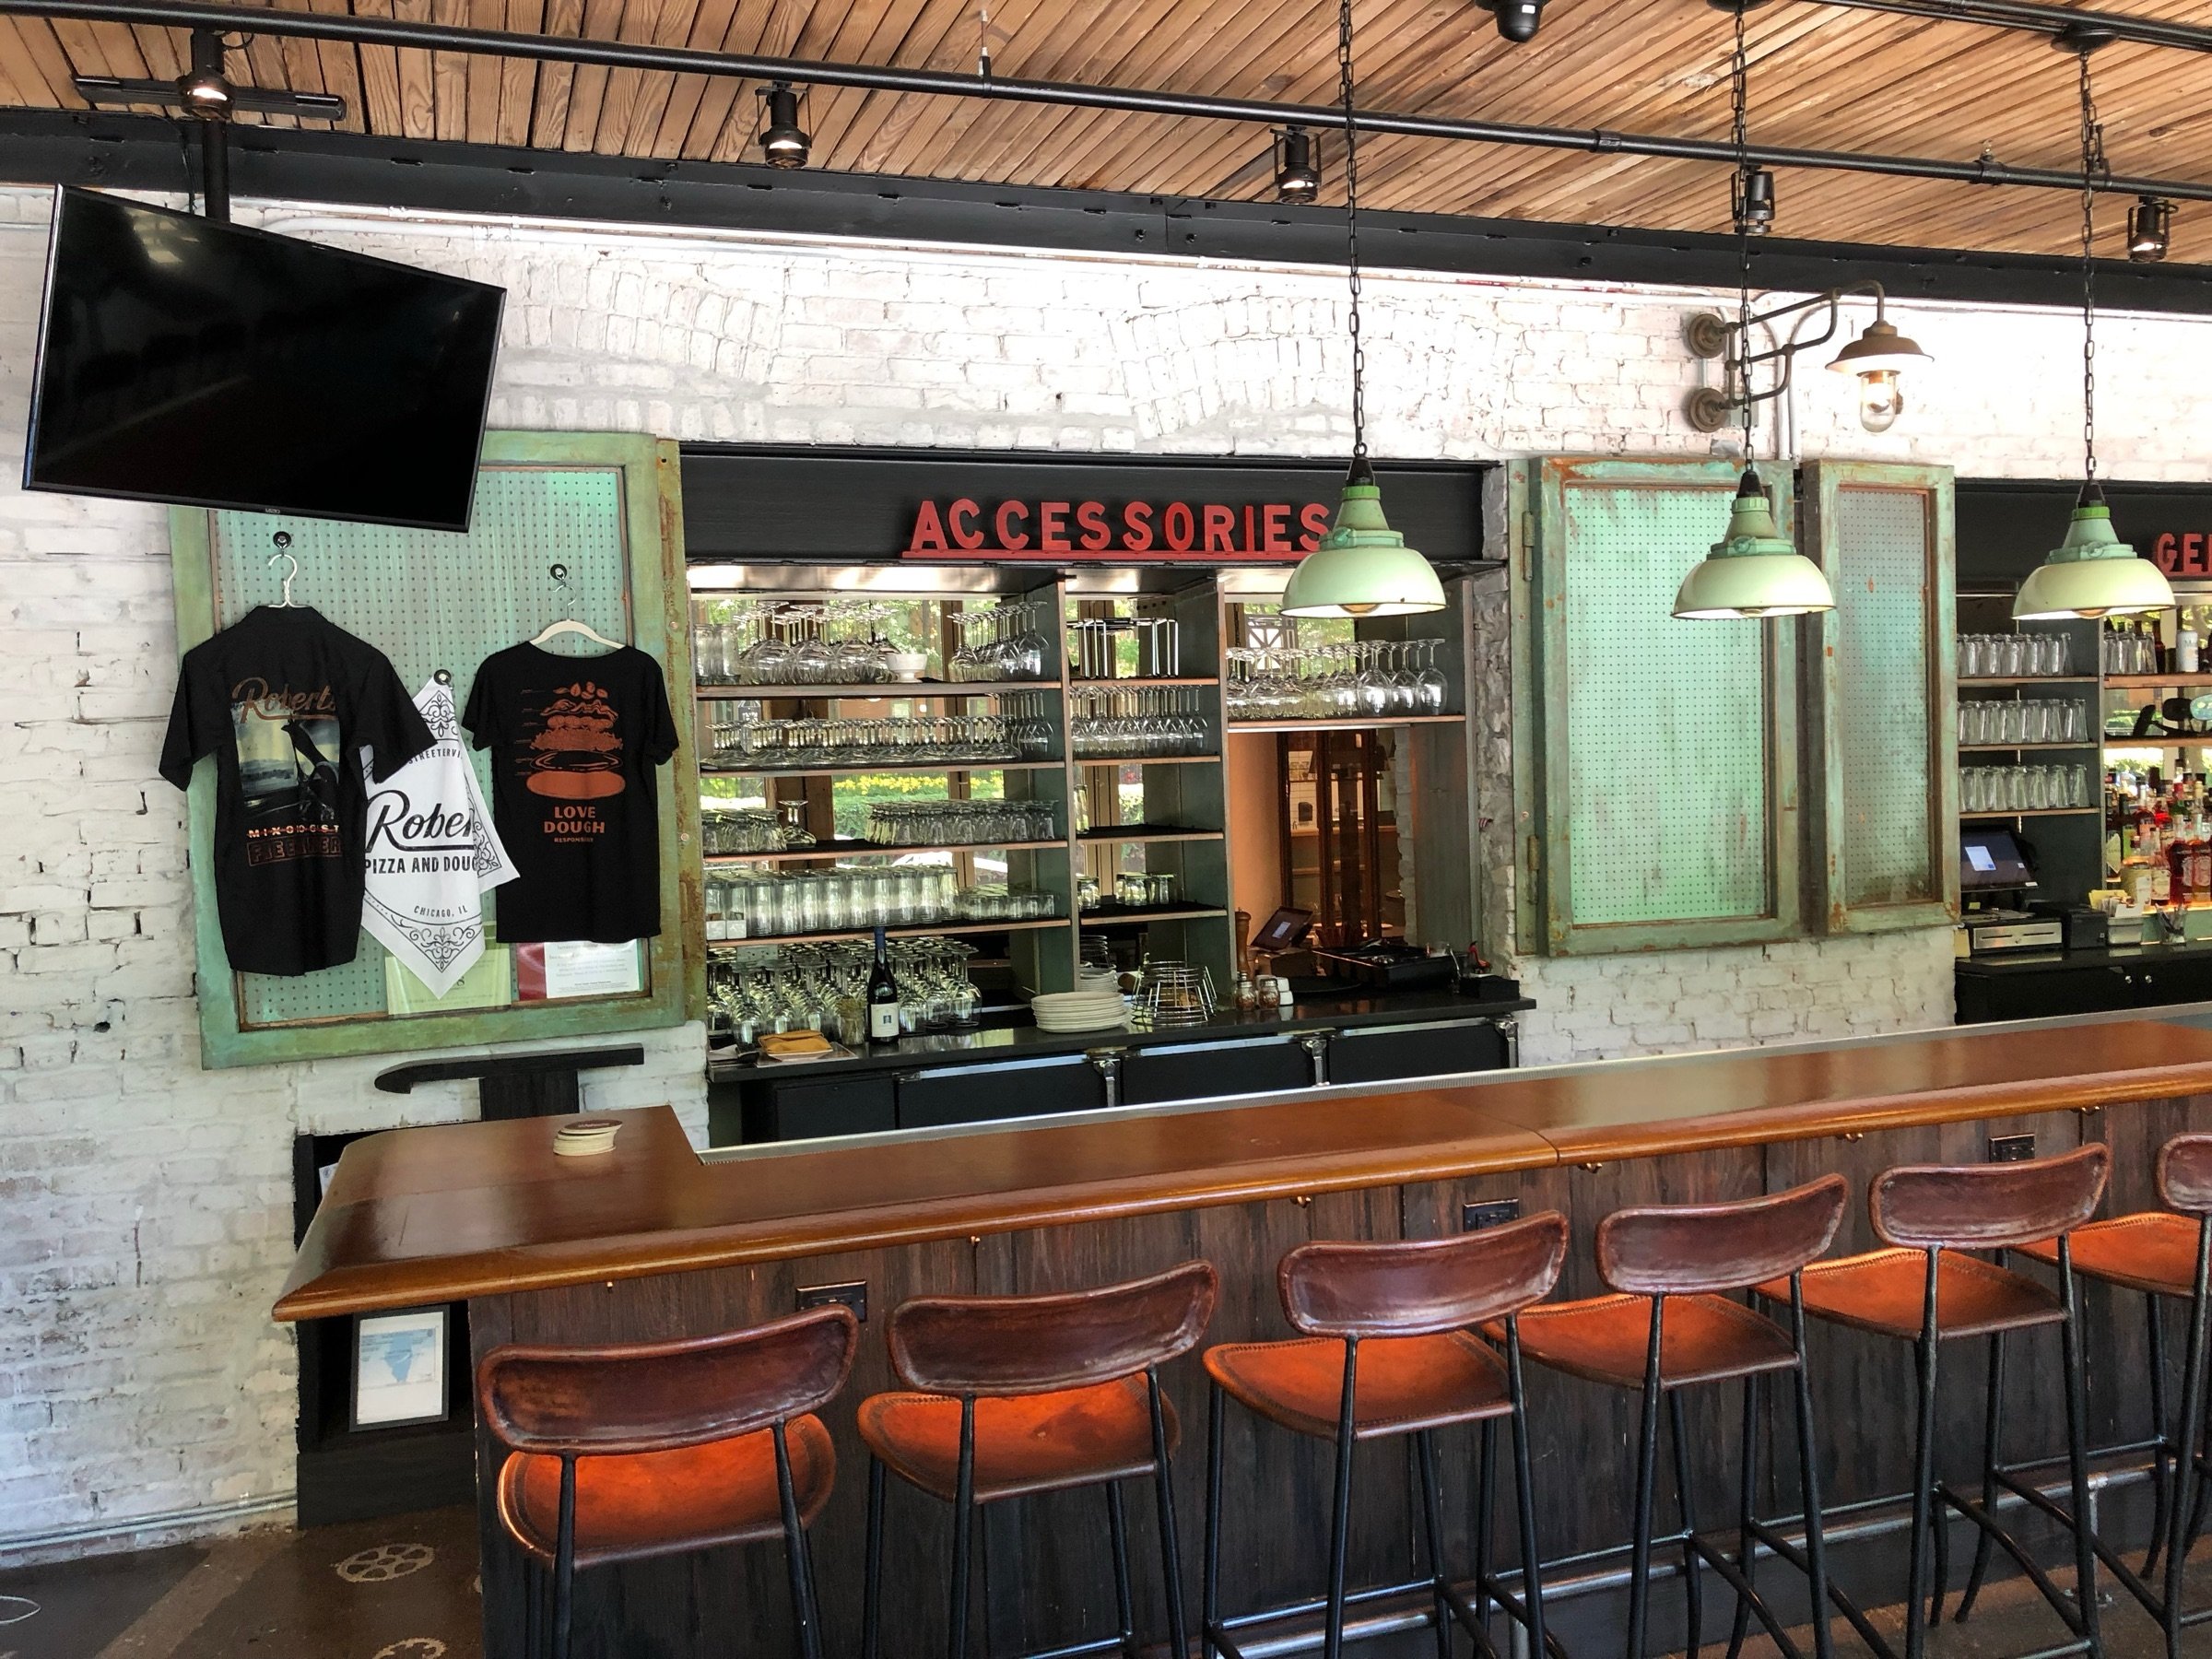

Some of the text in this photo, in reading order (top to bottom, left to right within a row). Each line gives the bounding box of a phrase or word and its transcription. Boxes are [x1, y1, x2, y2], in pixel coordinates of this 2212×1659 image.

[910, 498, 1331, 552] ACCESSORIES
[2157, 532, 2212, 573] GE
[408, 747, 462, 765] STREETERVI
[554, 806, 596, 818] LOVE
[544, 820, 606, 834] DOUGH
[365, 857, 406, 875] PIZZA
[411, 856, 440, 874] AND
[413, 904, 468, 918] CHICAGO, IL
